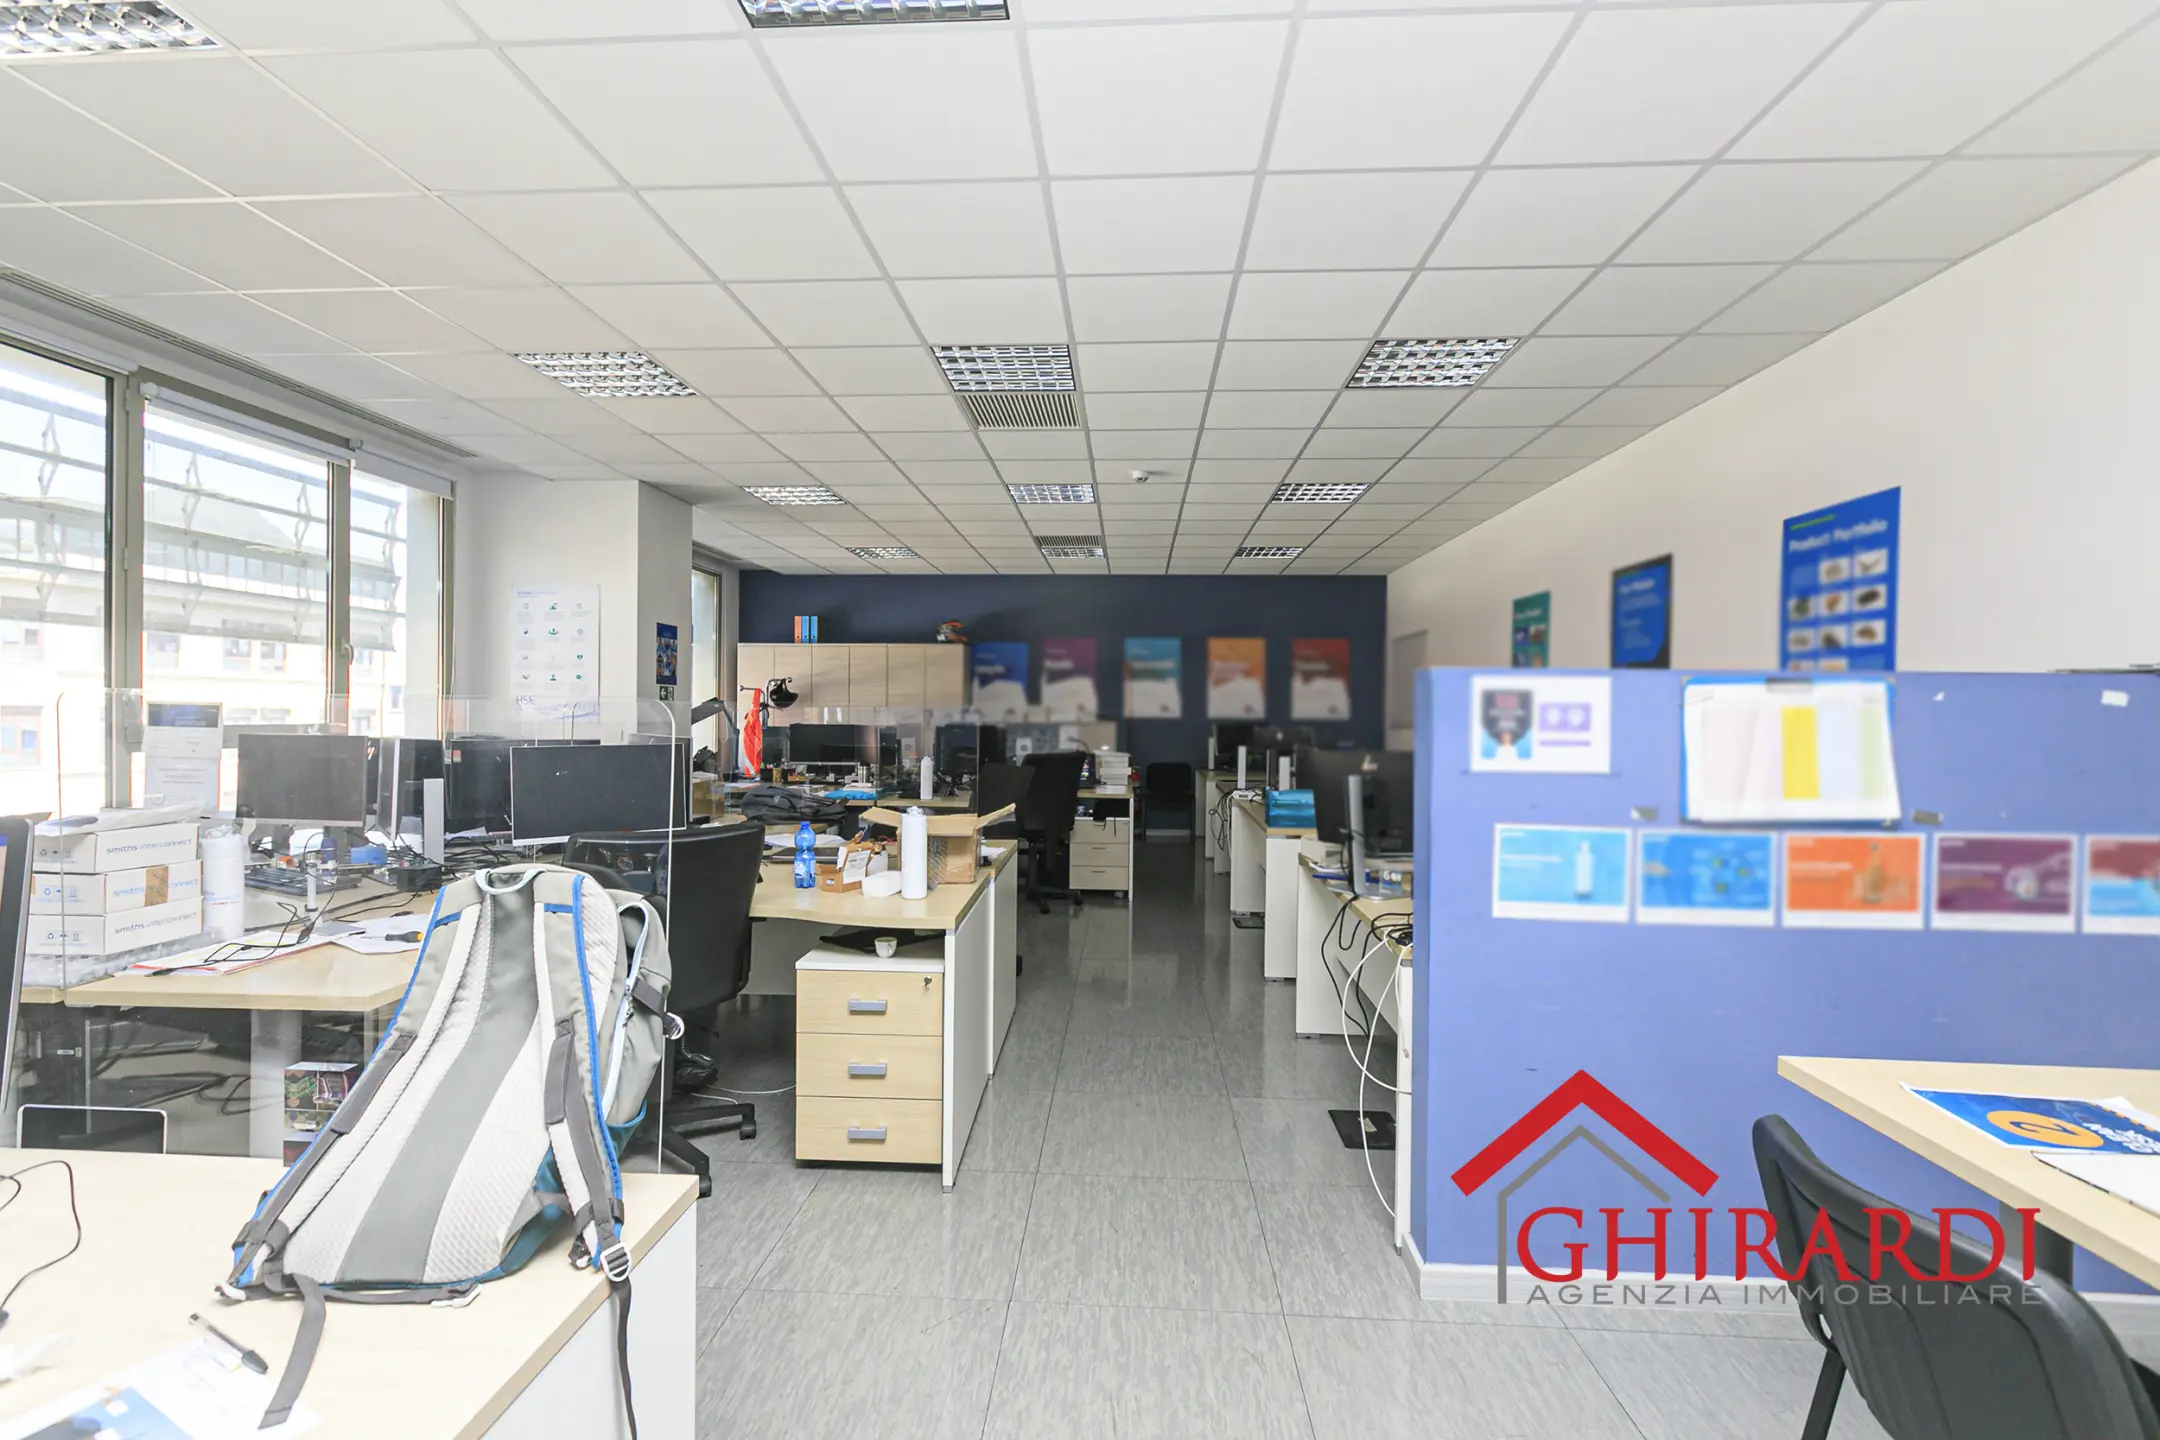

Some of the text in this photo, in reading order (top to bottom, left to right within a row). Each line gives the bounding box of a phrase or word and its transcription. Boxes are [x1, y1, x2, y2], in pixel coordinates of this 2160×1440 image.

[106, 838, 192, 854] smiths interconnect
[113, 887, 145, 897] smiths
[115, 911, 197, 935] smiths interconnect
